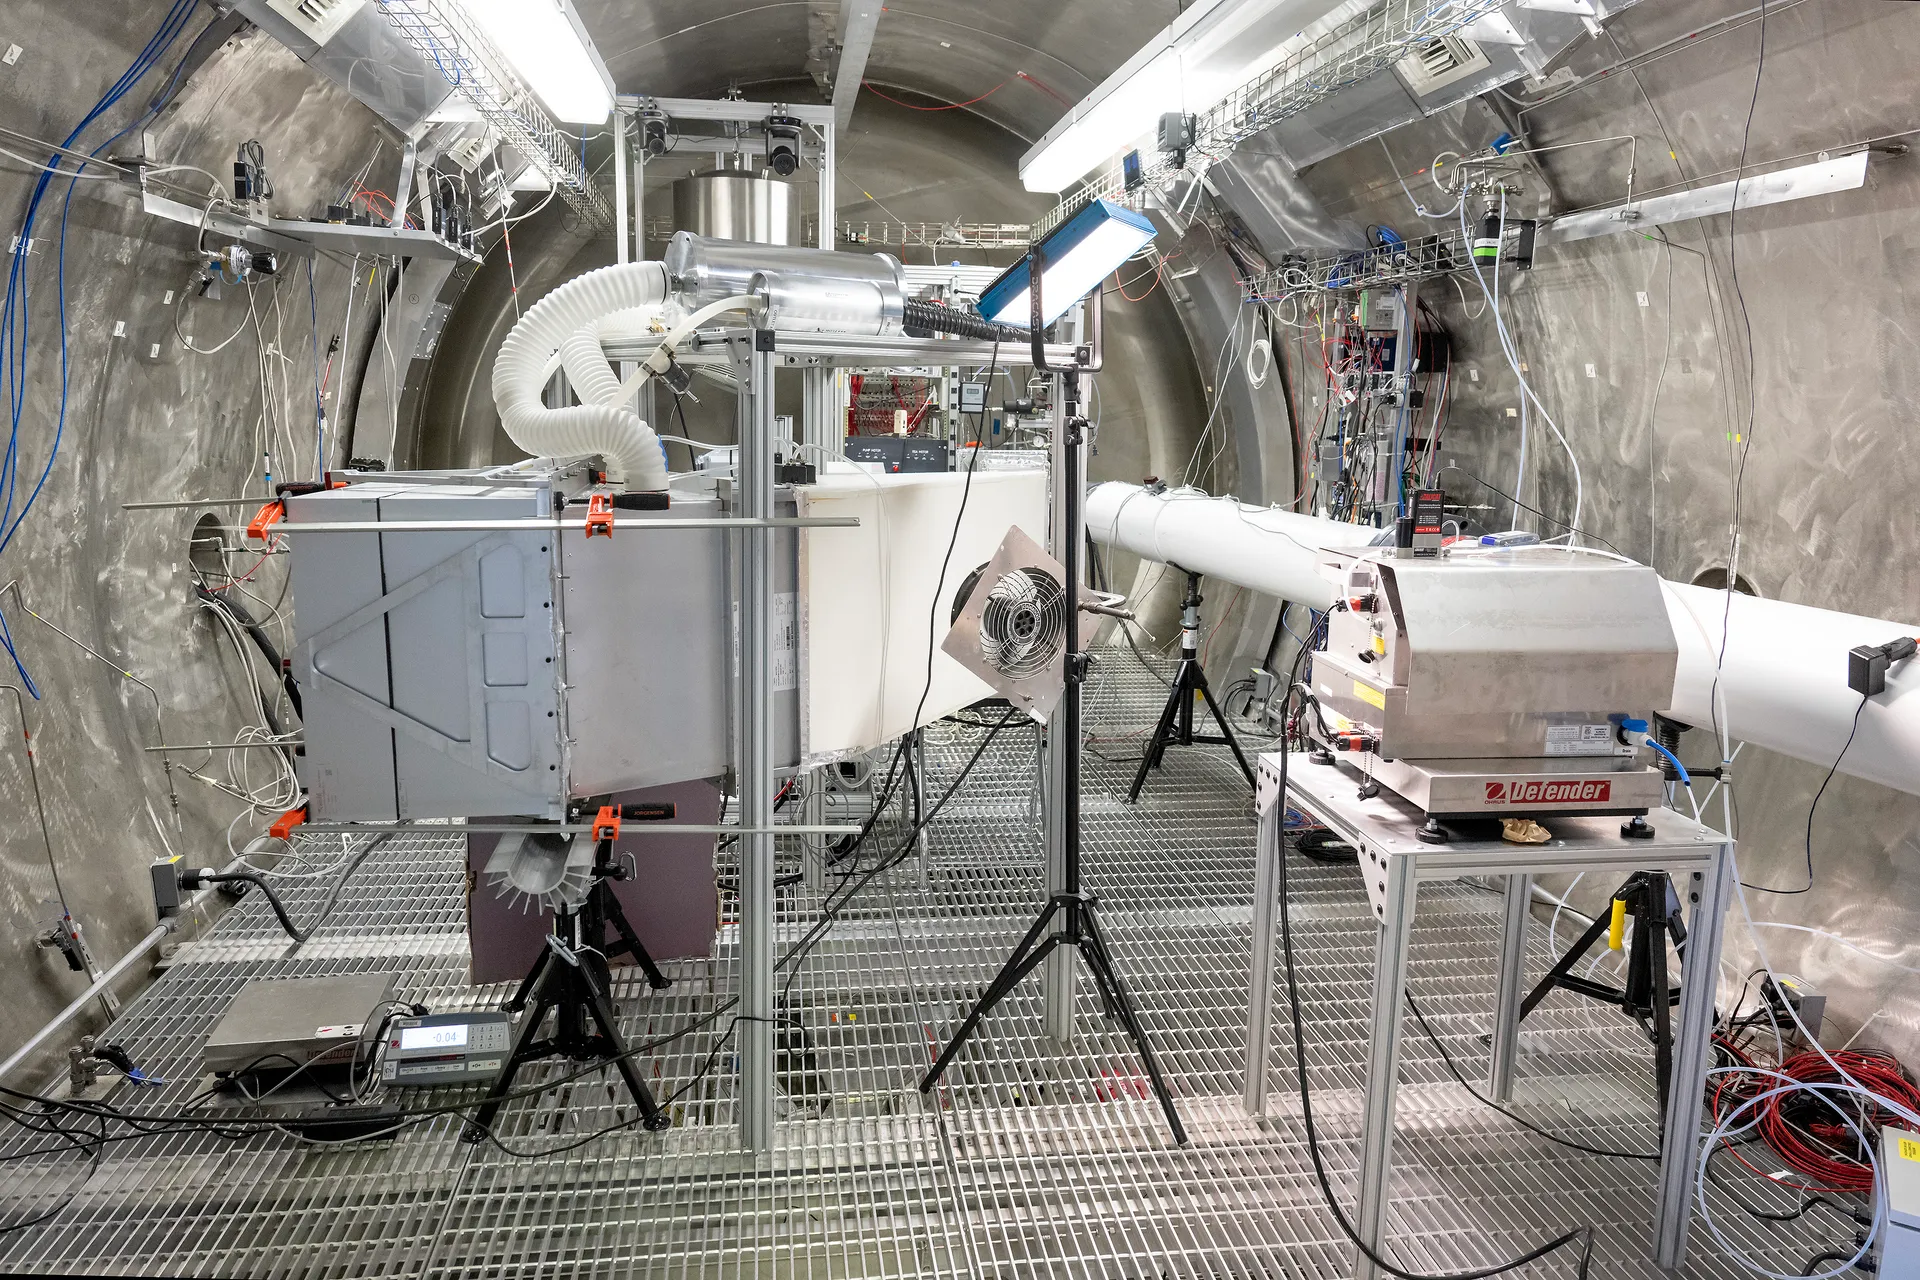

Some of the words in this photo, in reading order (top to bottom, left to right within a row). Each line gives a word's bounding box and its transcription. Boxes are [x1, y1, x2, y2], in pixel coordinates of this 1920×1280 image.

[1031, 276, 1040, 334] DRACAST
[1511, 780, 1605, 801] Defender
[433, 1032, 457, 1043] -0.04
